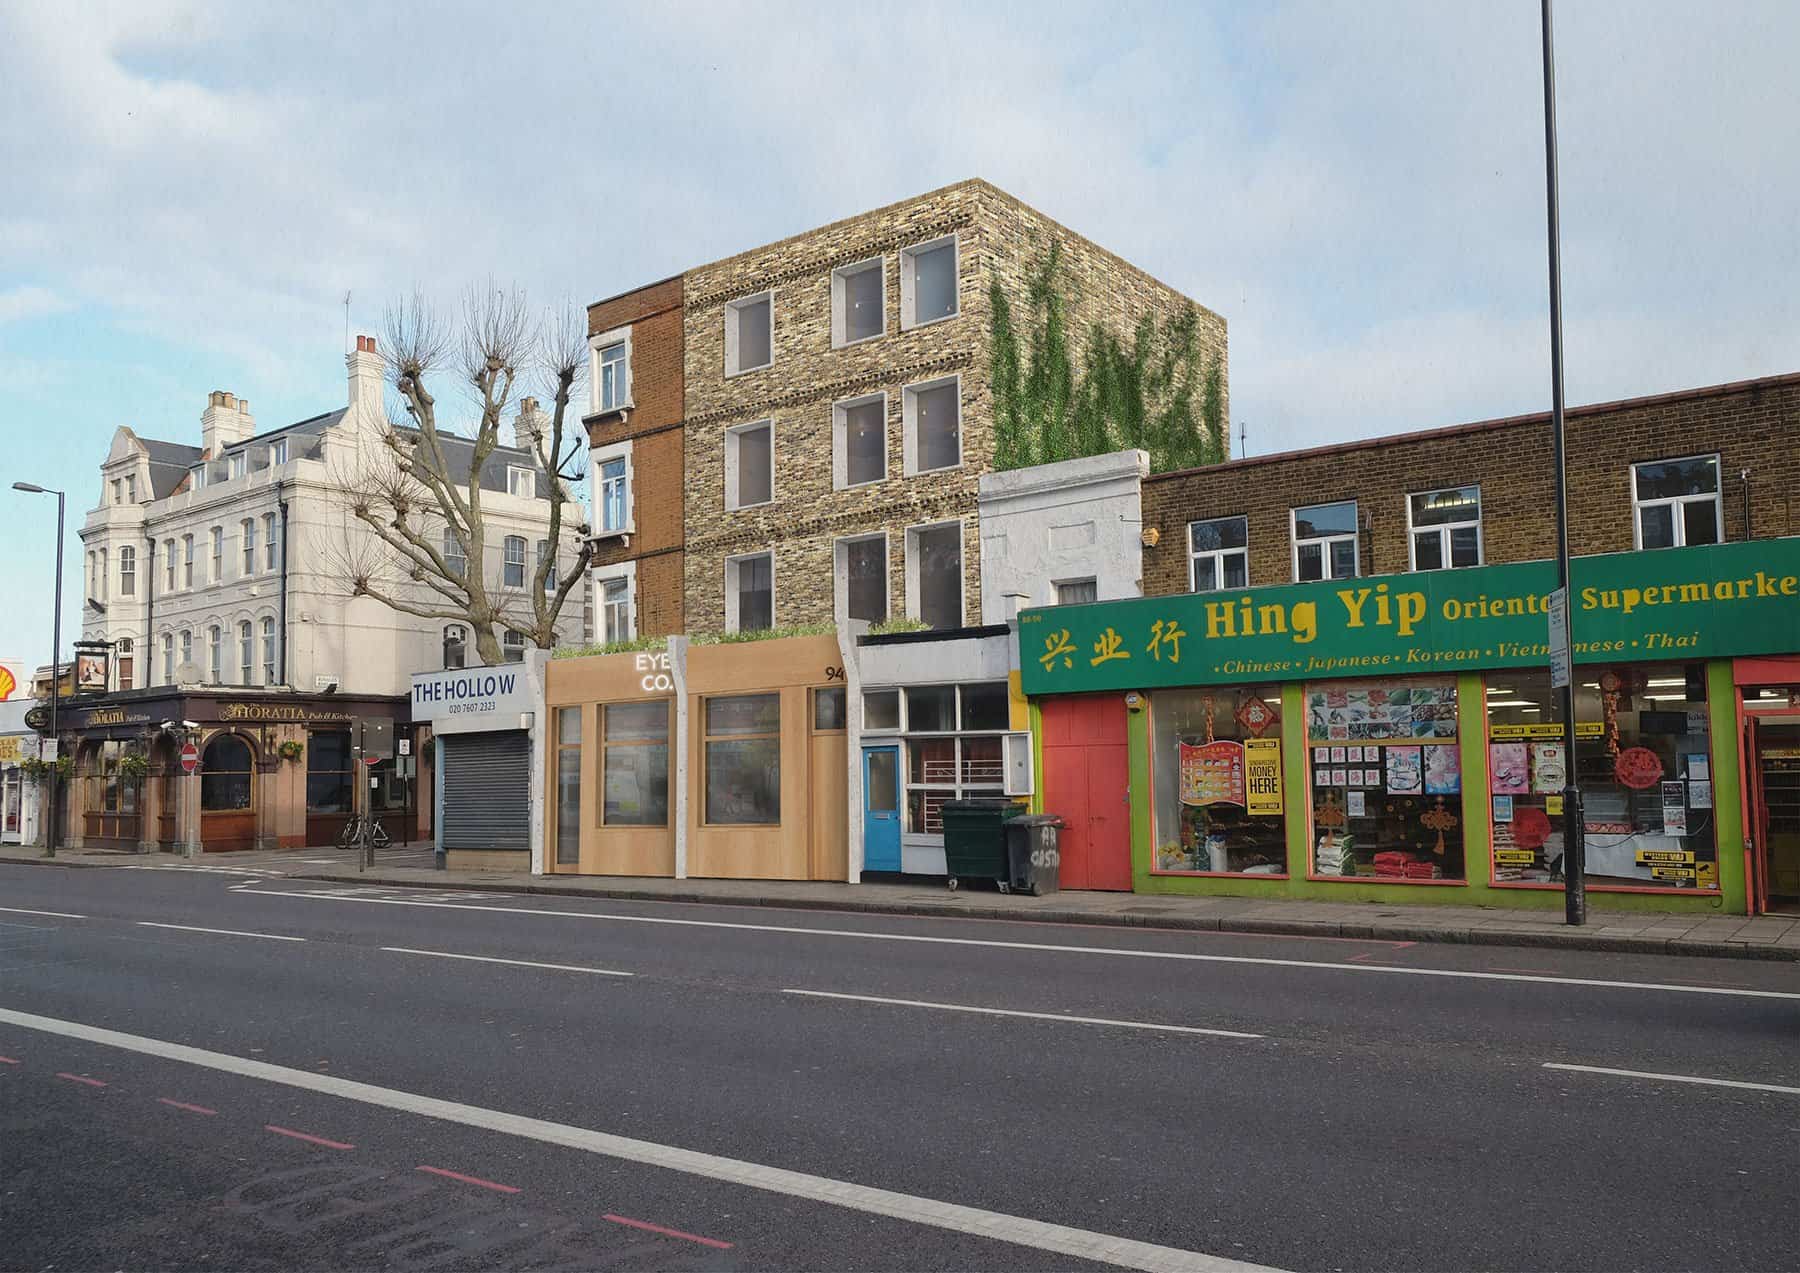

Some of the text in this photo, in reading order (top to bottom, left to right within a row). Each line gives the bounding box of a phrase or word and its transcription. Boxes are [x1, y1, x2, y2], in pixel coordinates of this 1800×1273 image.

[1205, 597, 1317, 643] Hing
[1337, 583, 1427, 636] Yip
[1443, 593, 1552, 620] Orienta
[1582, 572, 1798, 614] Supermarke
[1039, 619, 1187, 672] 兴业行
[1223, 631, 1700, 673] Chinese Japanese Korean Vietnmese Thai
[636, 653, 671, 670] EYE
[825, 666, 845, 681] 94
[413, 674, 515, 702] THE HOLLOW
[642, 674, 674, 691] CO.
[236, 705, 305, 720] HORATIA
[449, 701, 496, 714] 020 7607 2323
[1249, 766, 1276, 777] MONEY
[1250, 778, 1278, 794] HERE
